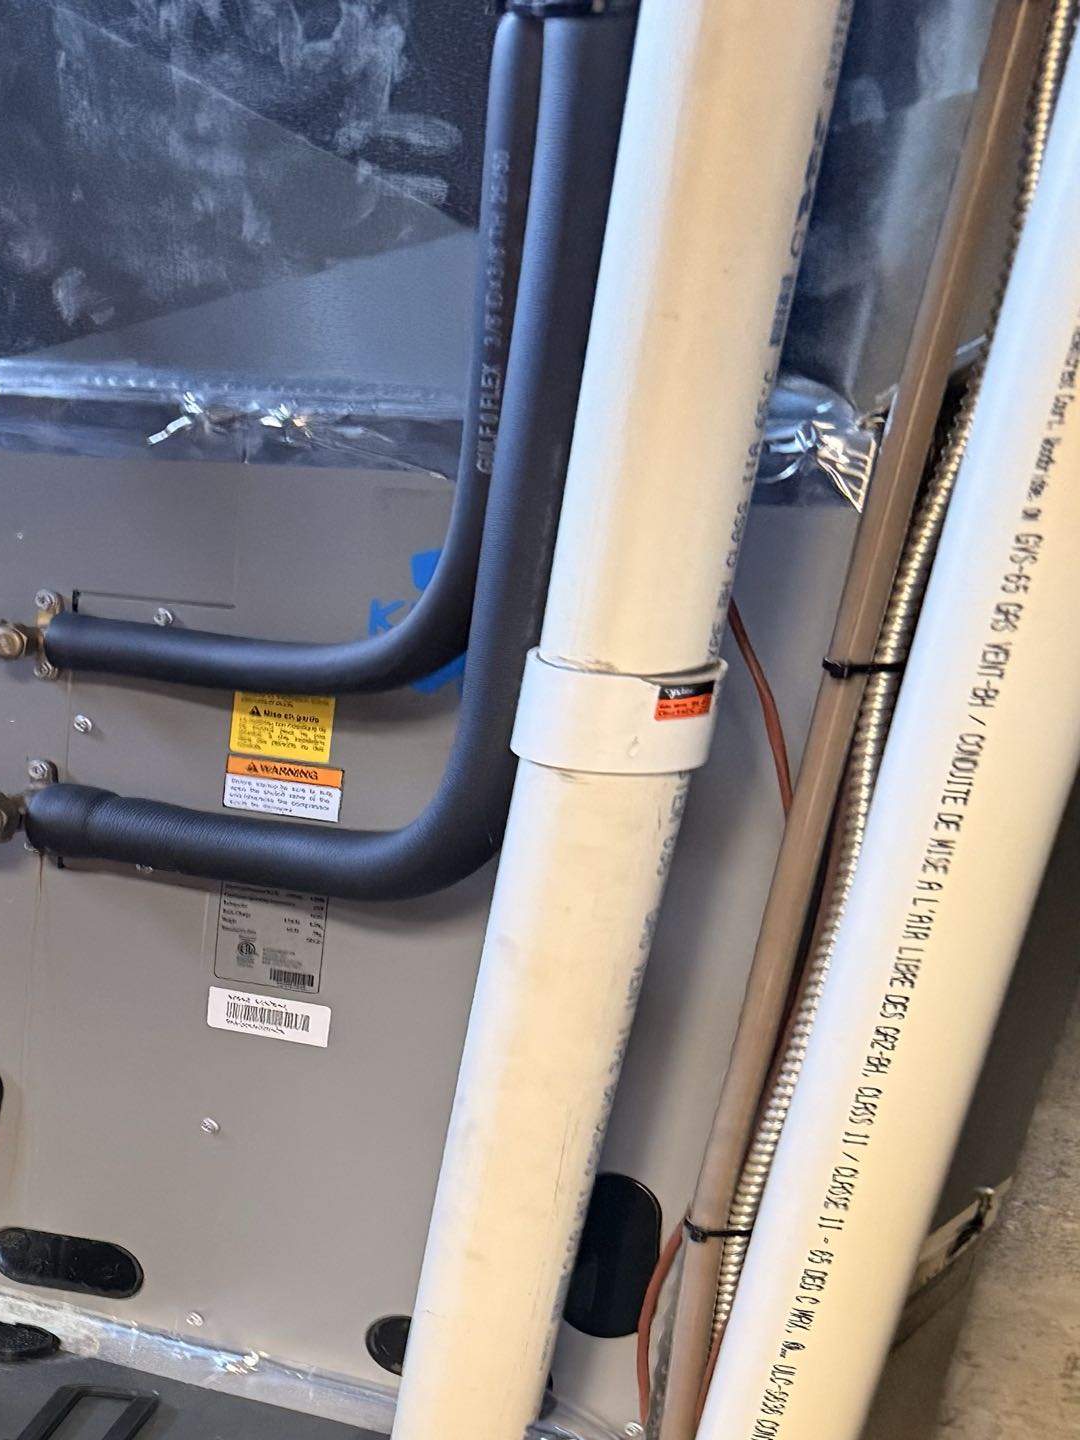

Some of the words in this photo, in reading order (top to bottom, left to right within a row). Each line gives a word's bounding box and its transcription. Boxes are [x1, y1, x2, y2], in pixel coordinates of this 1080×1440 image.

[259, 763, 319, 781] WARNING
[941, 733, 986, 806] CONDUITE
[933, 812, 964, 832] DE
[921, 838, 956, 875] MISE
[902, 897, 939, 940] L'AIR
[889, 946, 924, 989] LIBRE
[880, 994, 910, 1020] DES
[849, 1087, 883, 1125] CLASS
[824, 1166, 859, 1211] CLASSE
